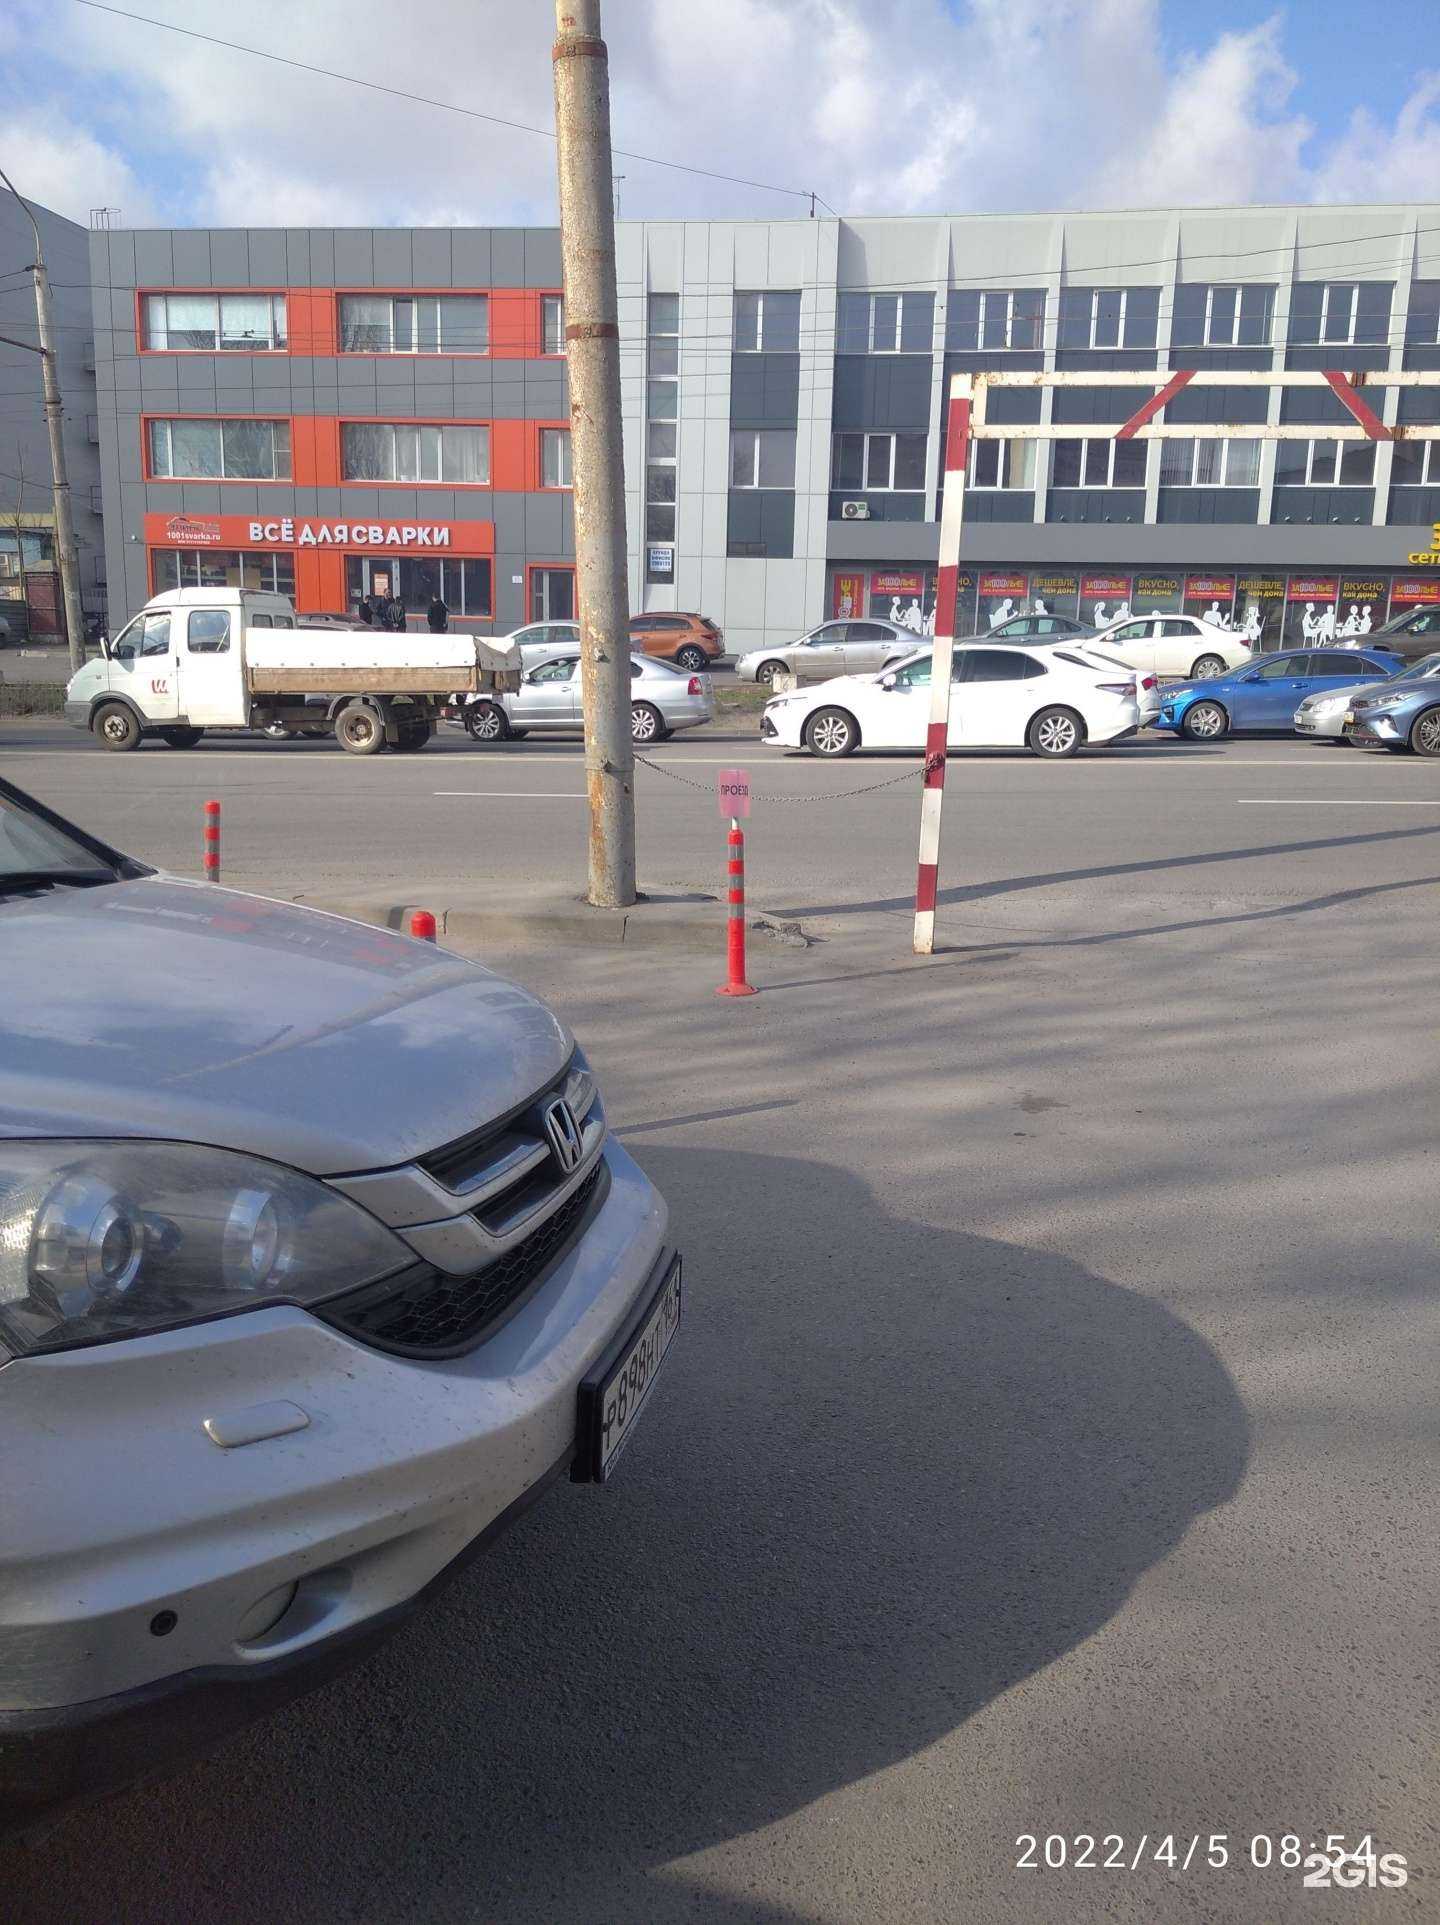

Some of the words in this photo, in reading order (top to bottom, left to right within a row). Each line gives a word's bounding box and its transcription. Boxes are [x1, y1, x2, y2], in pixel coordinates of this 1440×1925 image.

[167, 531, 221, 541] 1001svarka.ru
[249, 518, 294, 542] ВСЁ
[298, 523, 349, 546] ДЛЯ
[351, 525, 450, 546] СВАРКИ
[1344, 583, 1385, 592] ВКУСНО,
